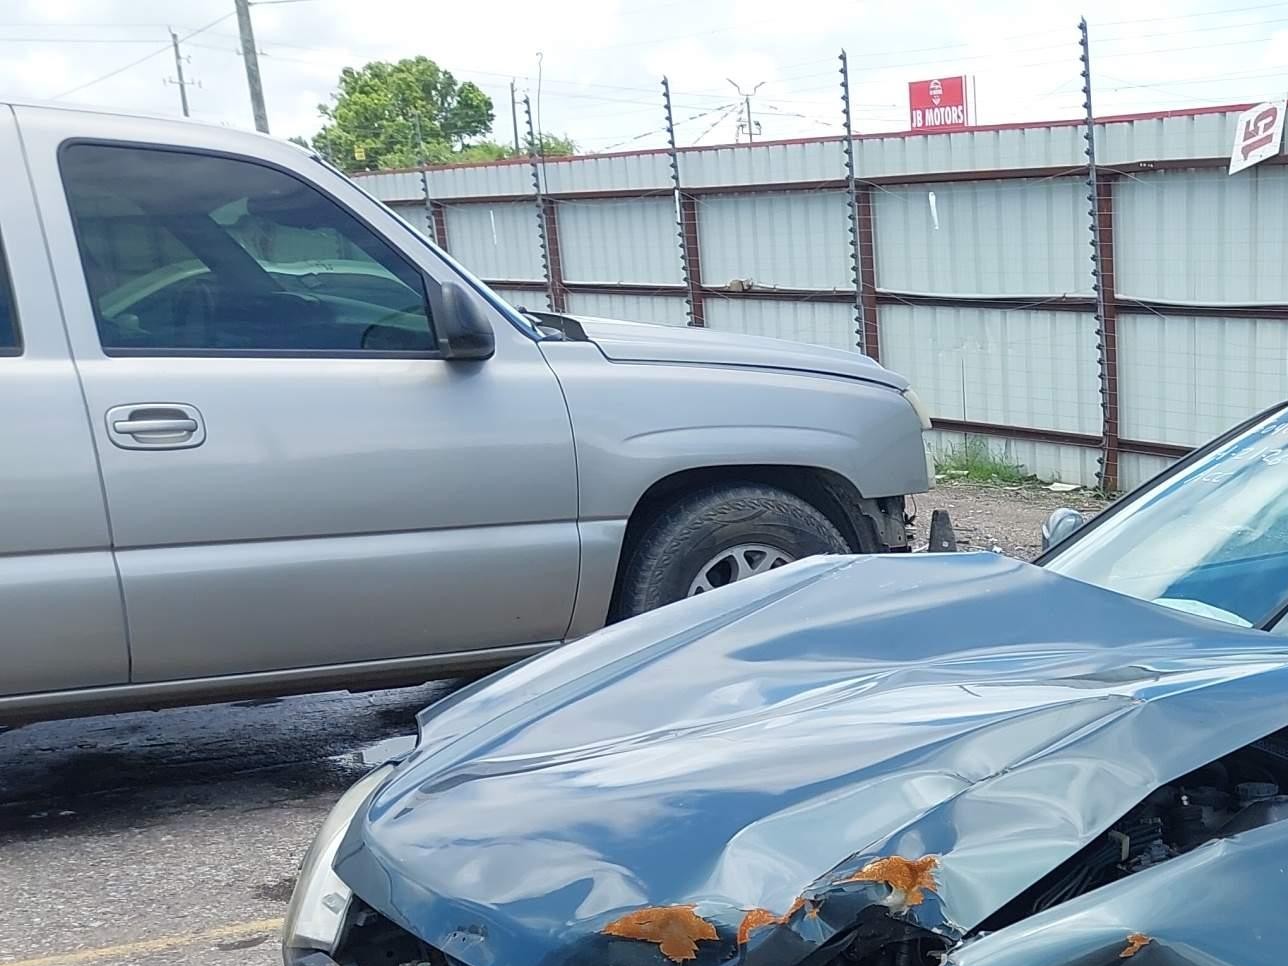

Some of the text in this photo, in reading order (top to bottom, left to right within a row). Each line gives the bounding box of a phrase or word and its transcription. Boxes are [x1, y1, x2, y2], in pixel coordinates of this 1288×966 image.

[912, 106, 964, 127] JB MOTORS
[1241, 107, 1278, 161] 15
